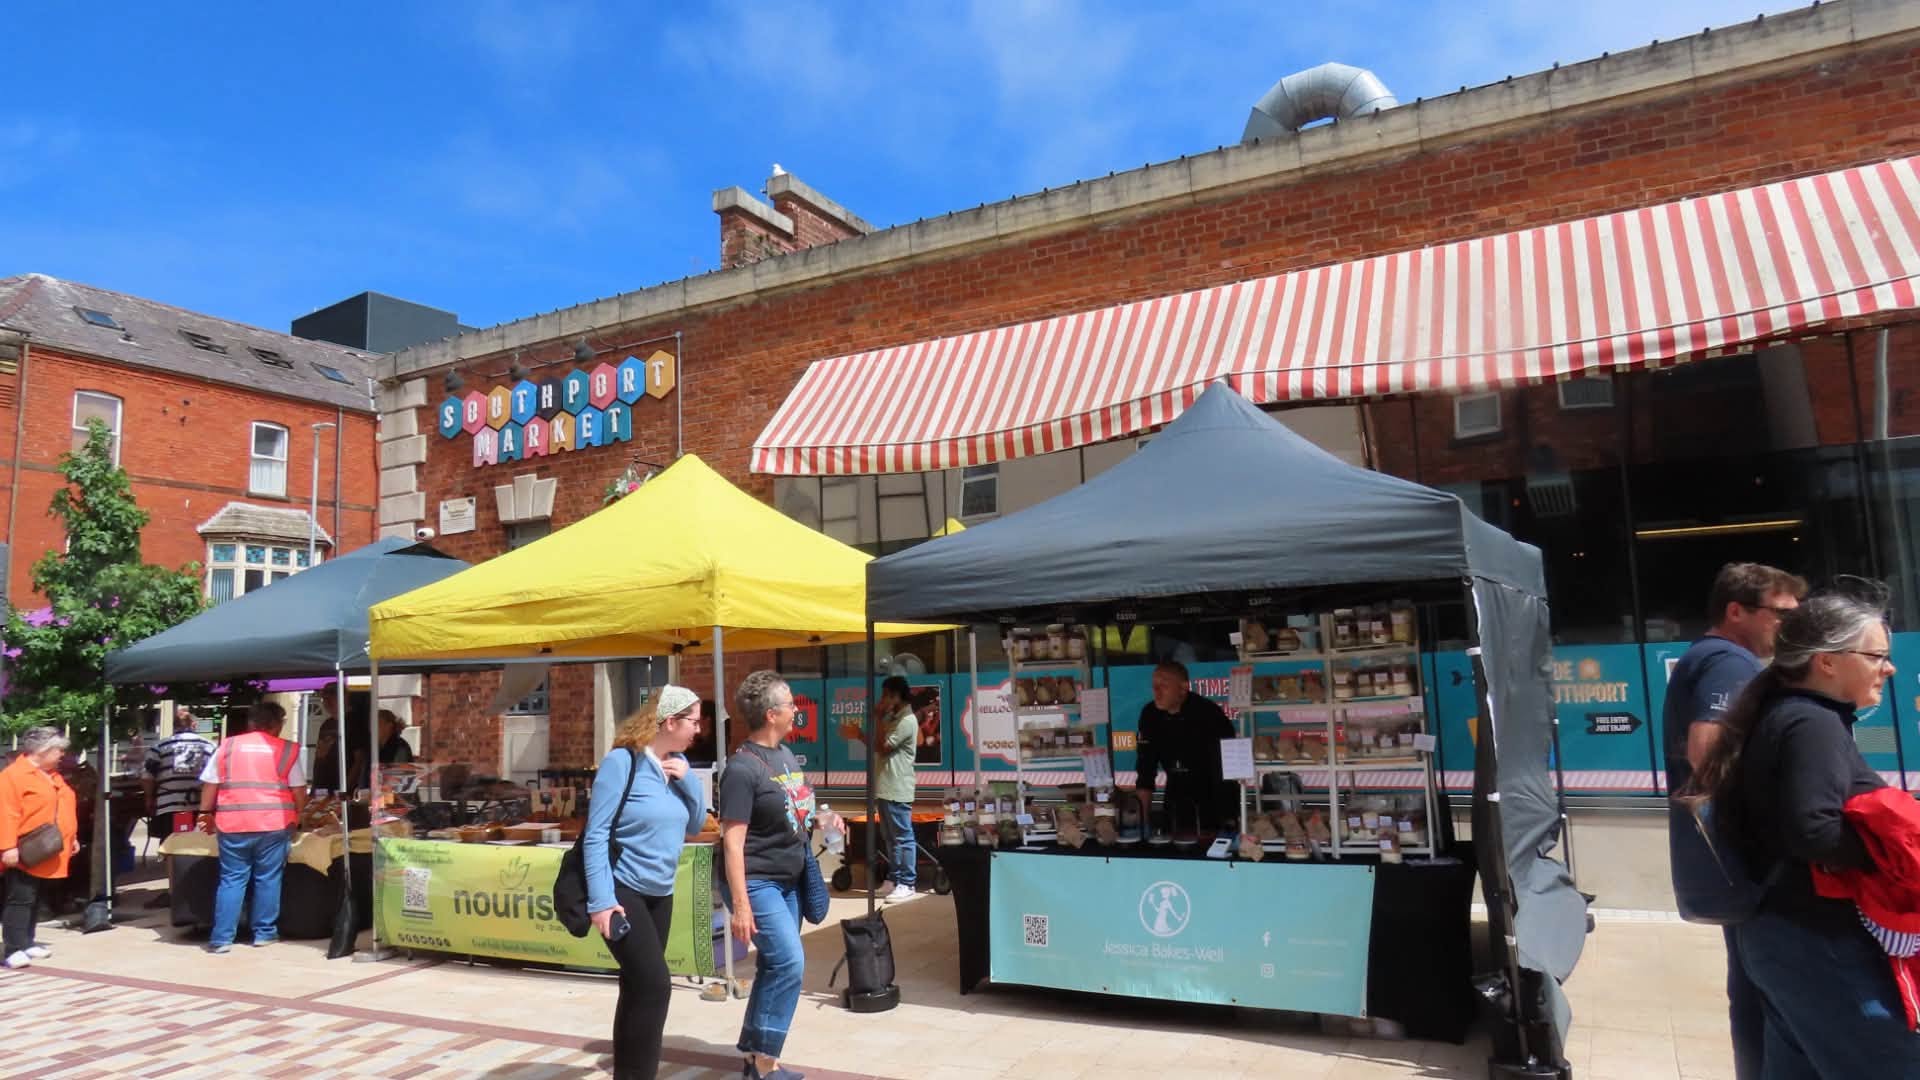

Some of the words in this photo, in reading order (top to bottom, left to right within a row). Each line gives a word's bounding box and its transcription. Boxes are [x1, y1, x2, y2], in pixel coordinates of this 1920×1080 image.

[443, 360, 665, 428] SOUTHPORT
[477, 407, 622, 457] MARKET
[1112, 735, 1132, 748] LIVE
[454, 887, 561, 921] nouris
[1102, 936, 1149, 958] Jessica
[1152, 942, 1225, 962] Bakes-Well
